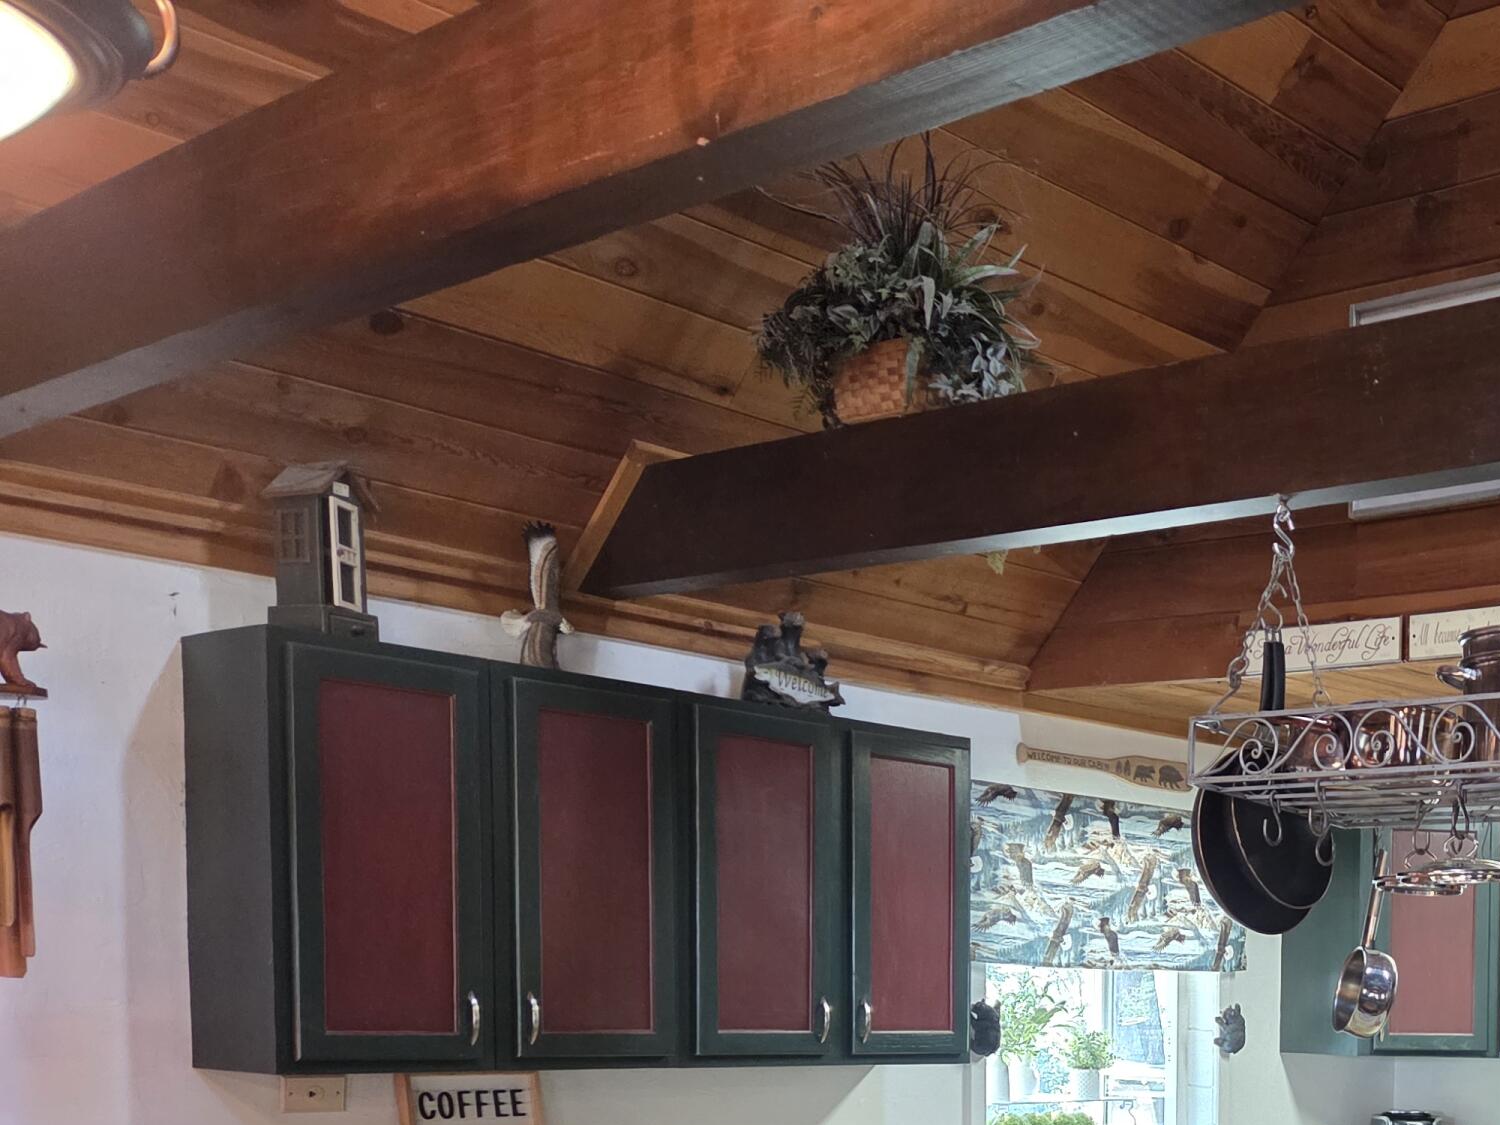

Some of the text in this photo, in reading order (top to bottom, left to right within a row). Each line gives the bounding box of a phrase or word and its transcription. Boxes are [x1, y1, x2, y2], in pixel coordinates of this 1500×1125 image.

[1290, 624, 1369, 663] Wonderful
[1361, 622, 1393, 660] Life
[776, 670, 828, 698] Welcome
[1026, 751, 1061, 764] WELCOME
[418, 1088, 527, 1120] COFFEE
